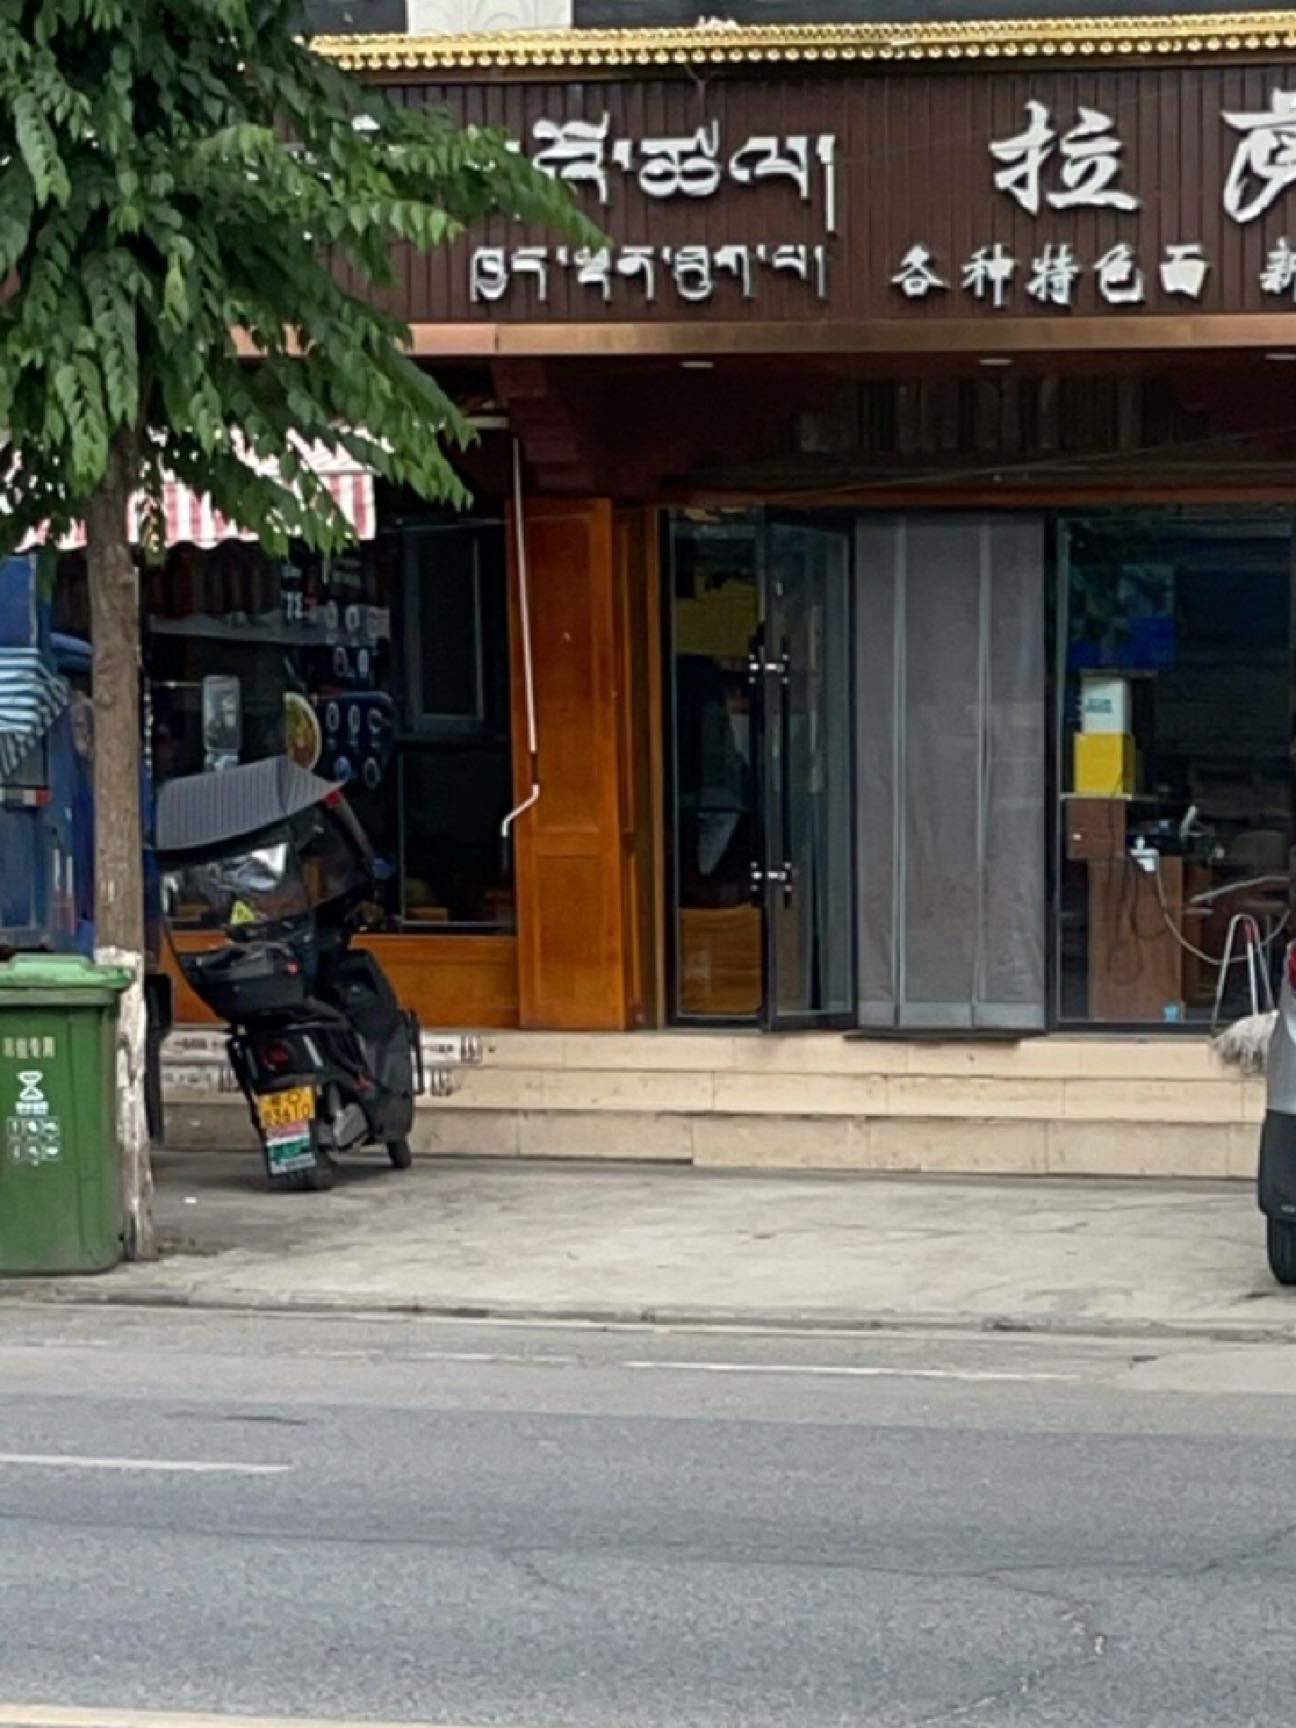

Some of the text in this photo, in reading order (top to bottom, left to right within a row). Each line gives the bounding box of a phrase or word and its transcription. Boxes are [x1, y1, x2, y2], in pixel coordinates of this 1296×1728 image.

[892, 243, 1208, 306] 各种特色面
